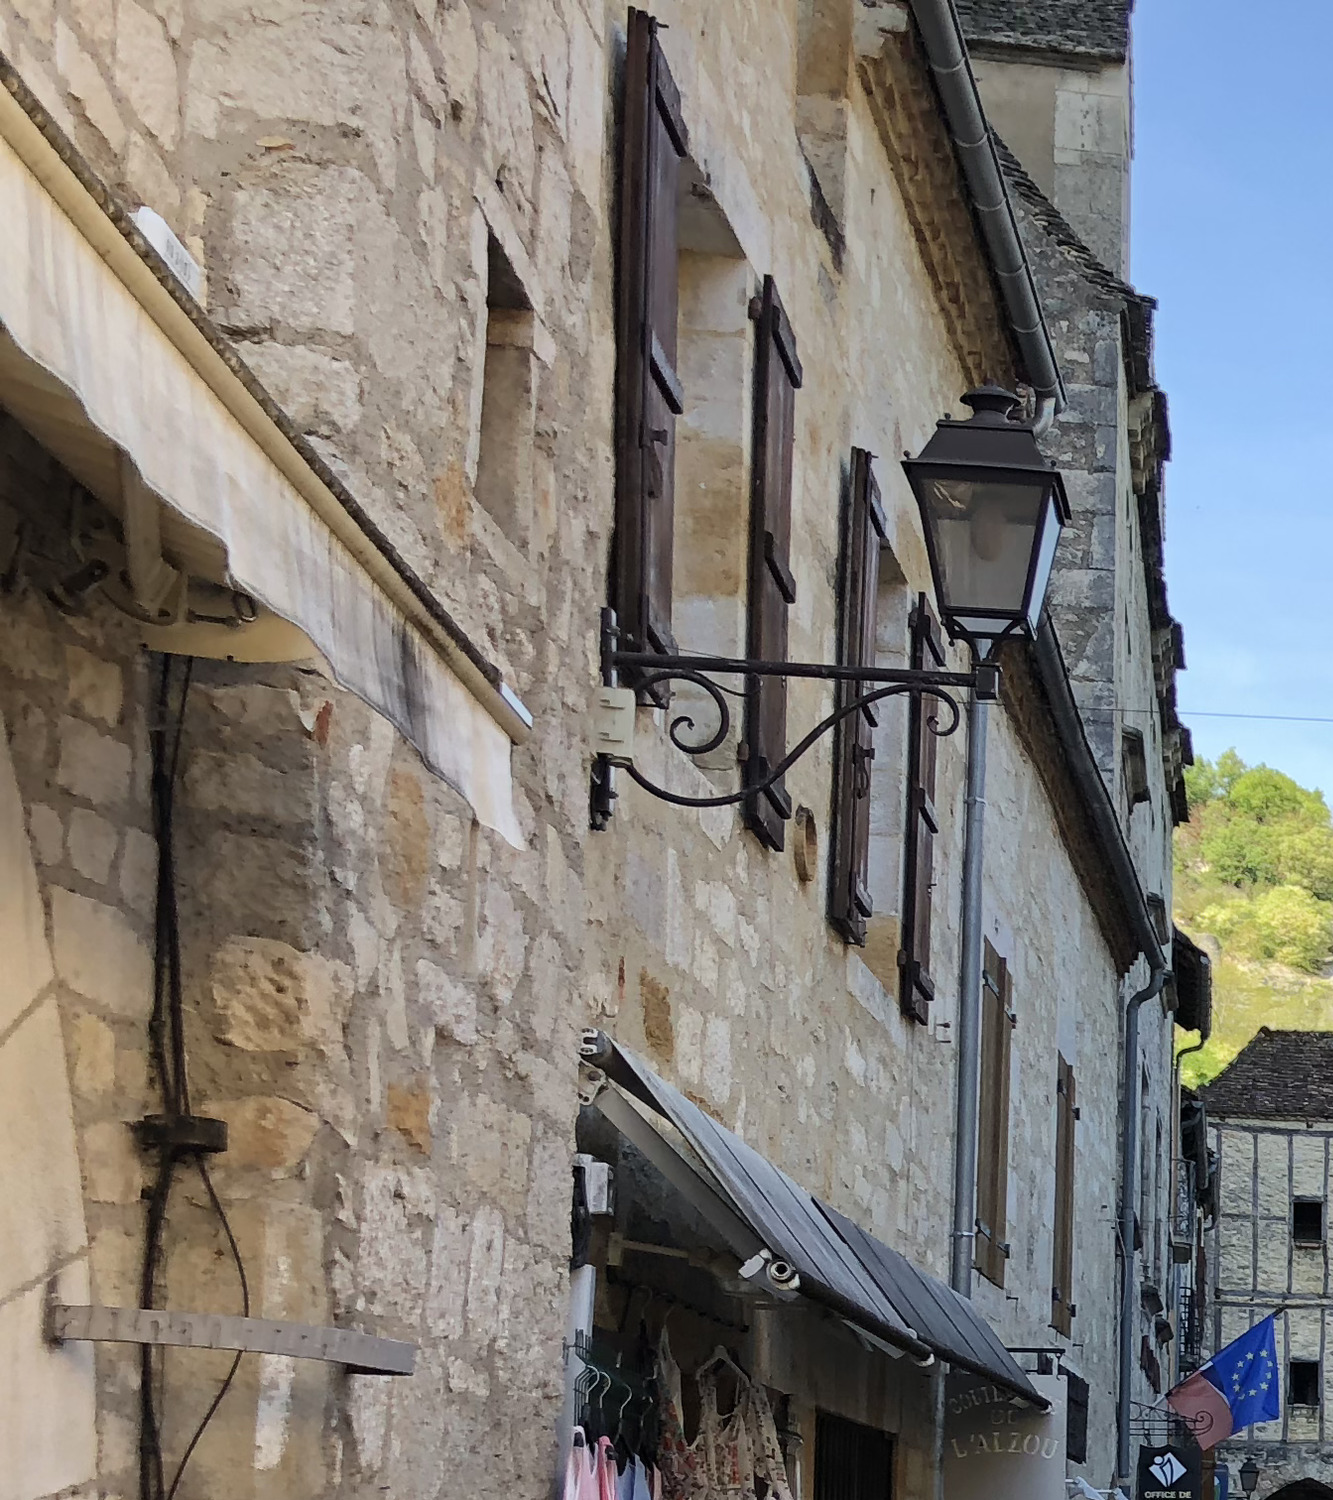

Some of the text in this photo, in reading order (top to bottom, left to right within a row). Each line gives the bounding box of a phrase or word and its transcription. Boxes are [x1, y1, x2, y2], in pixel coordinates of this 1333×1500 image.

[951, 1432, 1059, 1459] L'ALZOU
[1144, 1491, 1192, 1499] OFFICE DE
